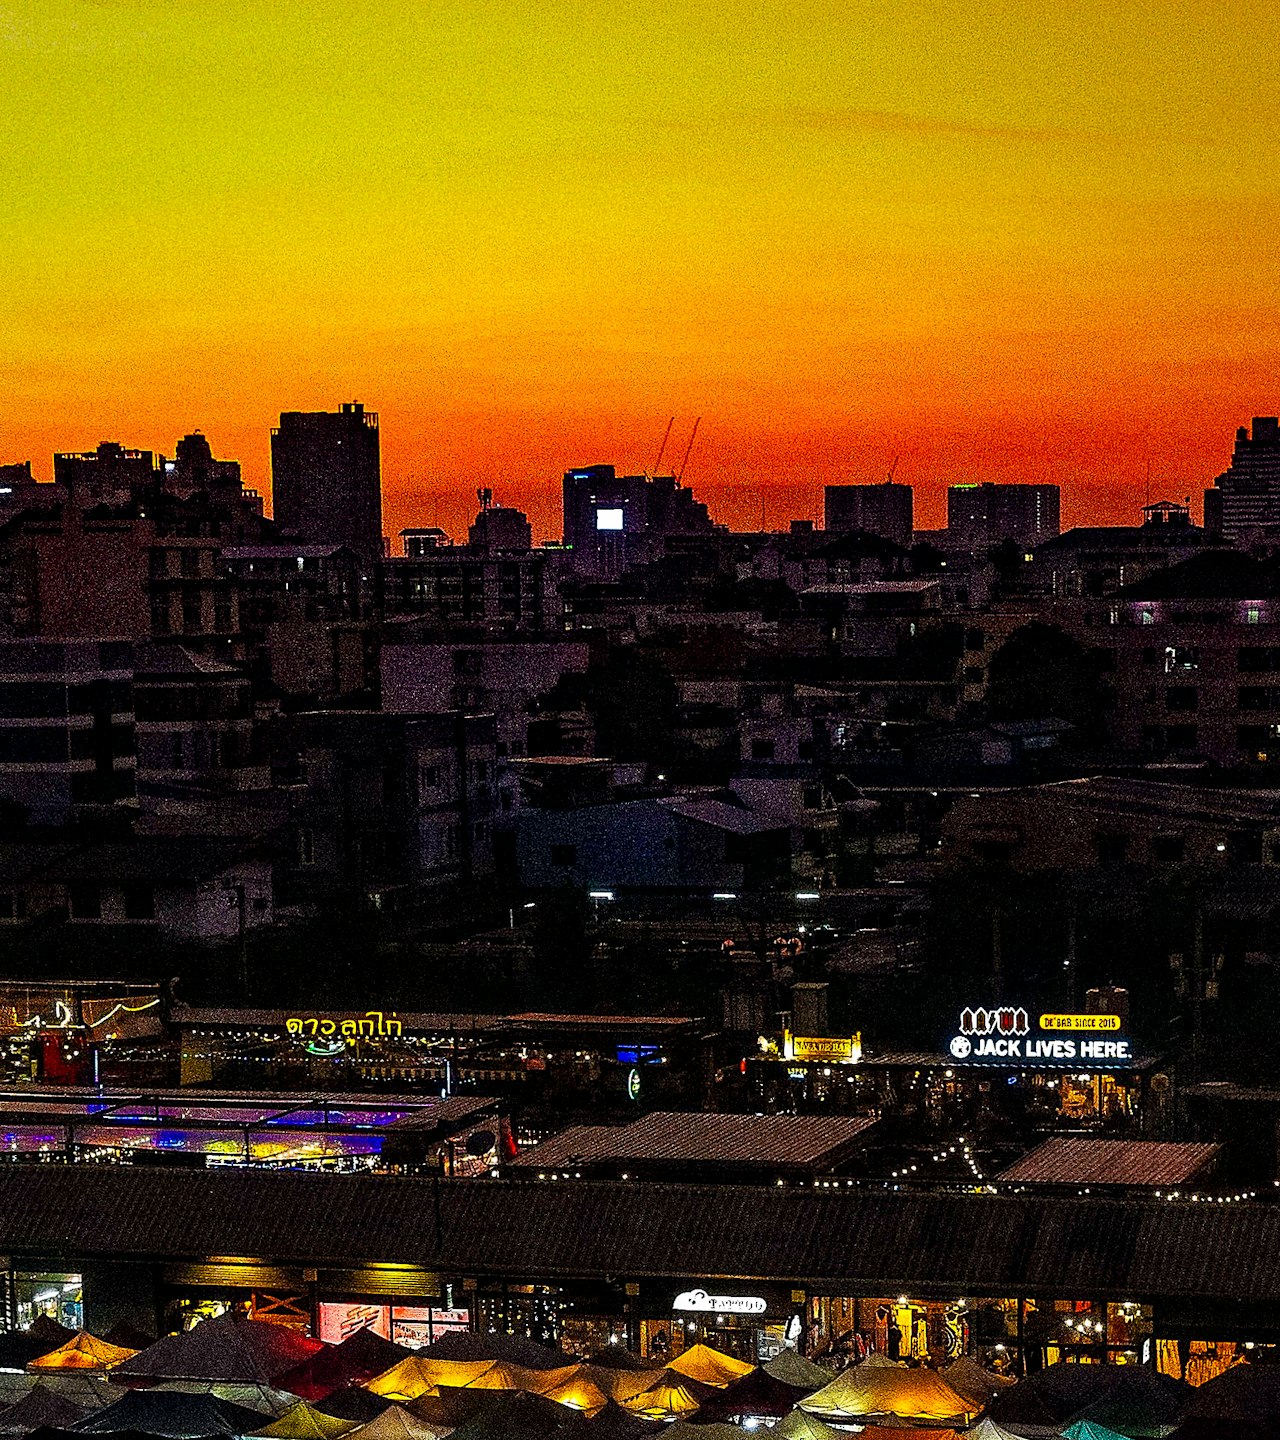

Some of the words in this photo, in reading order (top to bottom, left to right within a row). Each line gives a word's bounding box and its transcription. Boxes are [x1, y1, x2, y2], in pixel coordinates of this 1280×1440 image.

[1075, 1017, 1096, 1028] SINCE
[1098, 1018, 1116, 1028] 2015
[974, 1039, 1021, 1057] JACK
[1025, 1040, 1076, 1058] LIVES
[1080, 1041, 1133, 1059] HERE.
